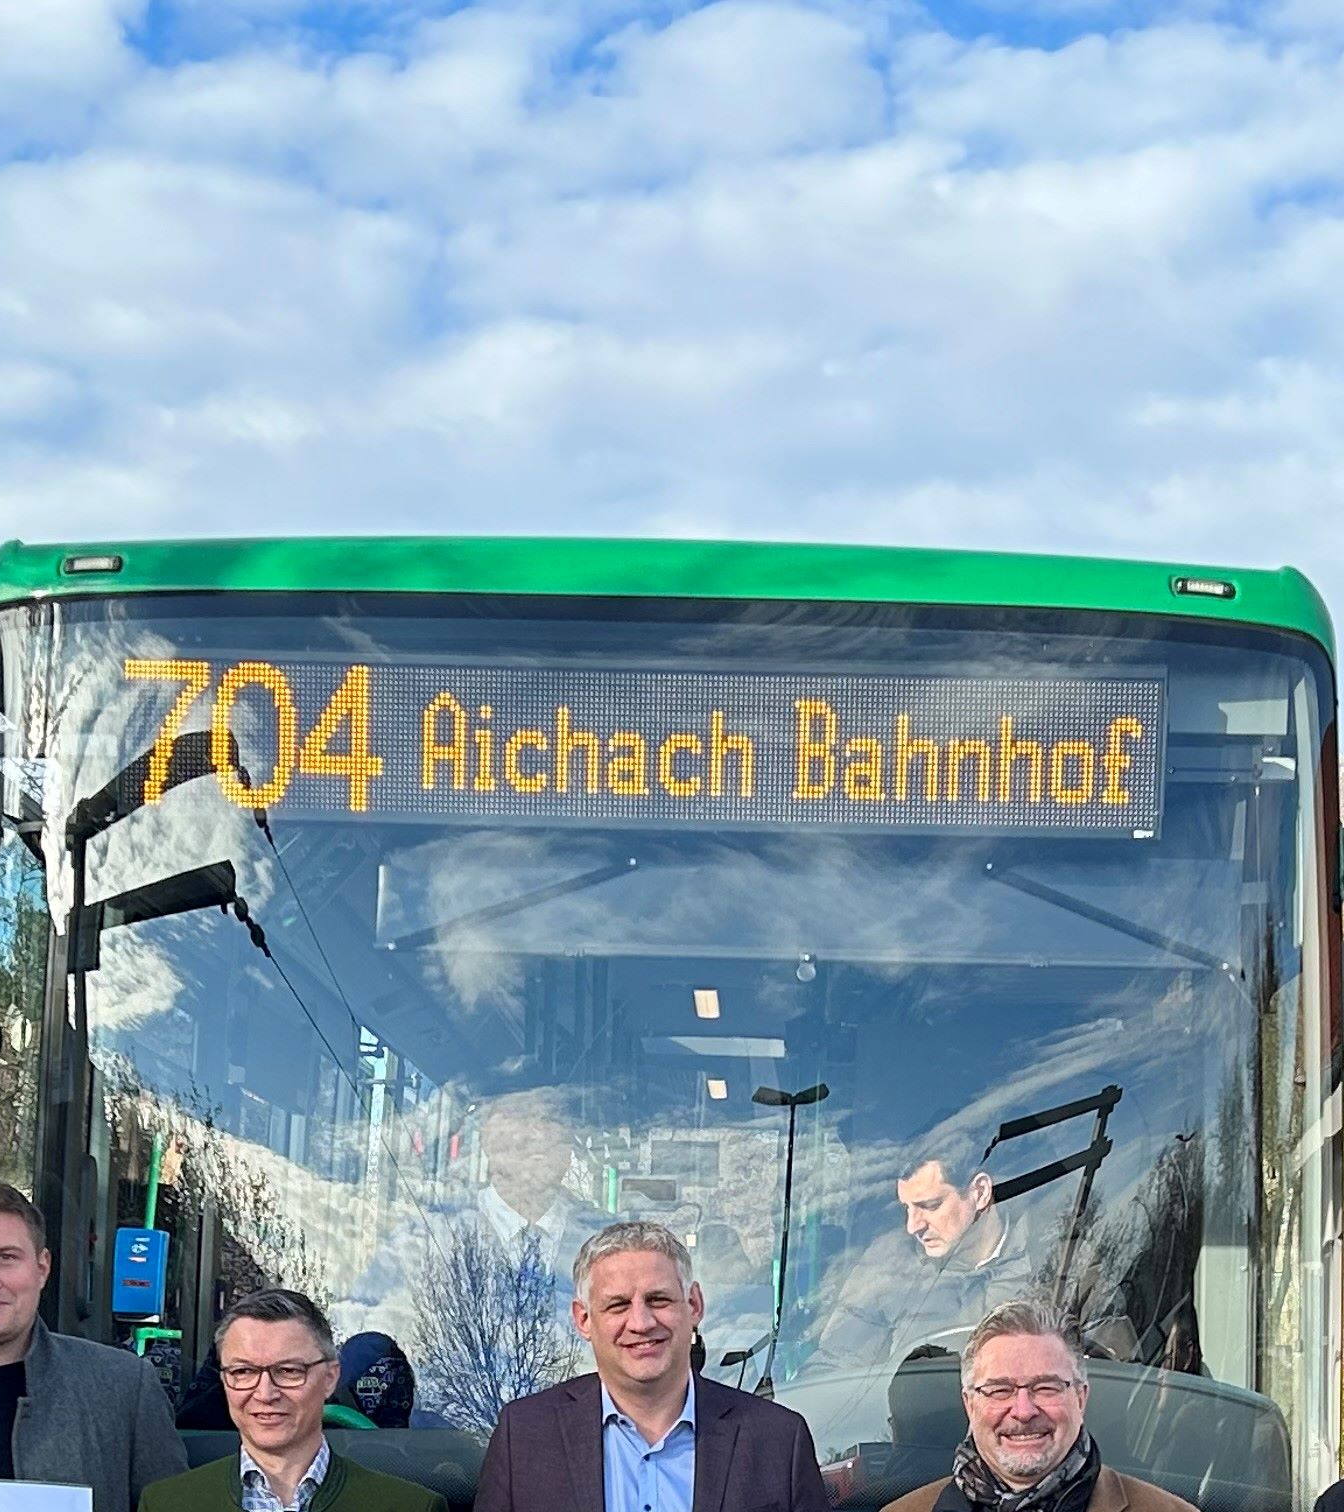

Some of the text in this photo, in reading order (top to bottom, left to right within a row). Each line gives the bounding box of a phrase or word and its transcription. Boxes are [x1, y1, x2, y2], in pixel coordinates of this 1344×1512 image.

[124, 659, 1144, 812] 704 Aichach Bahnhof
